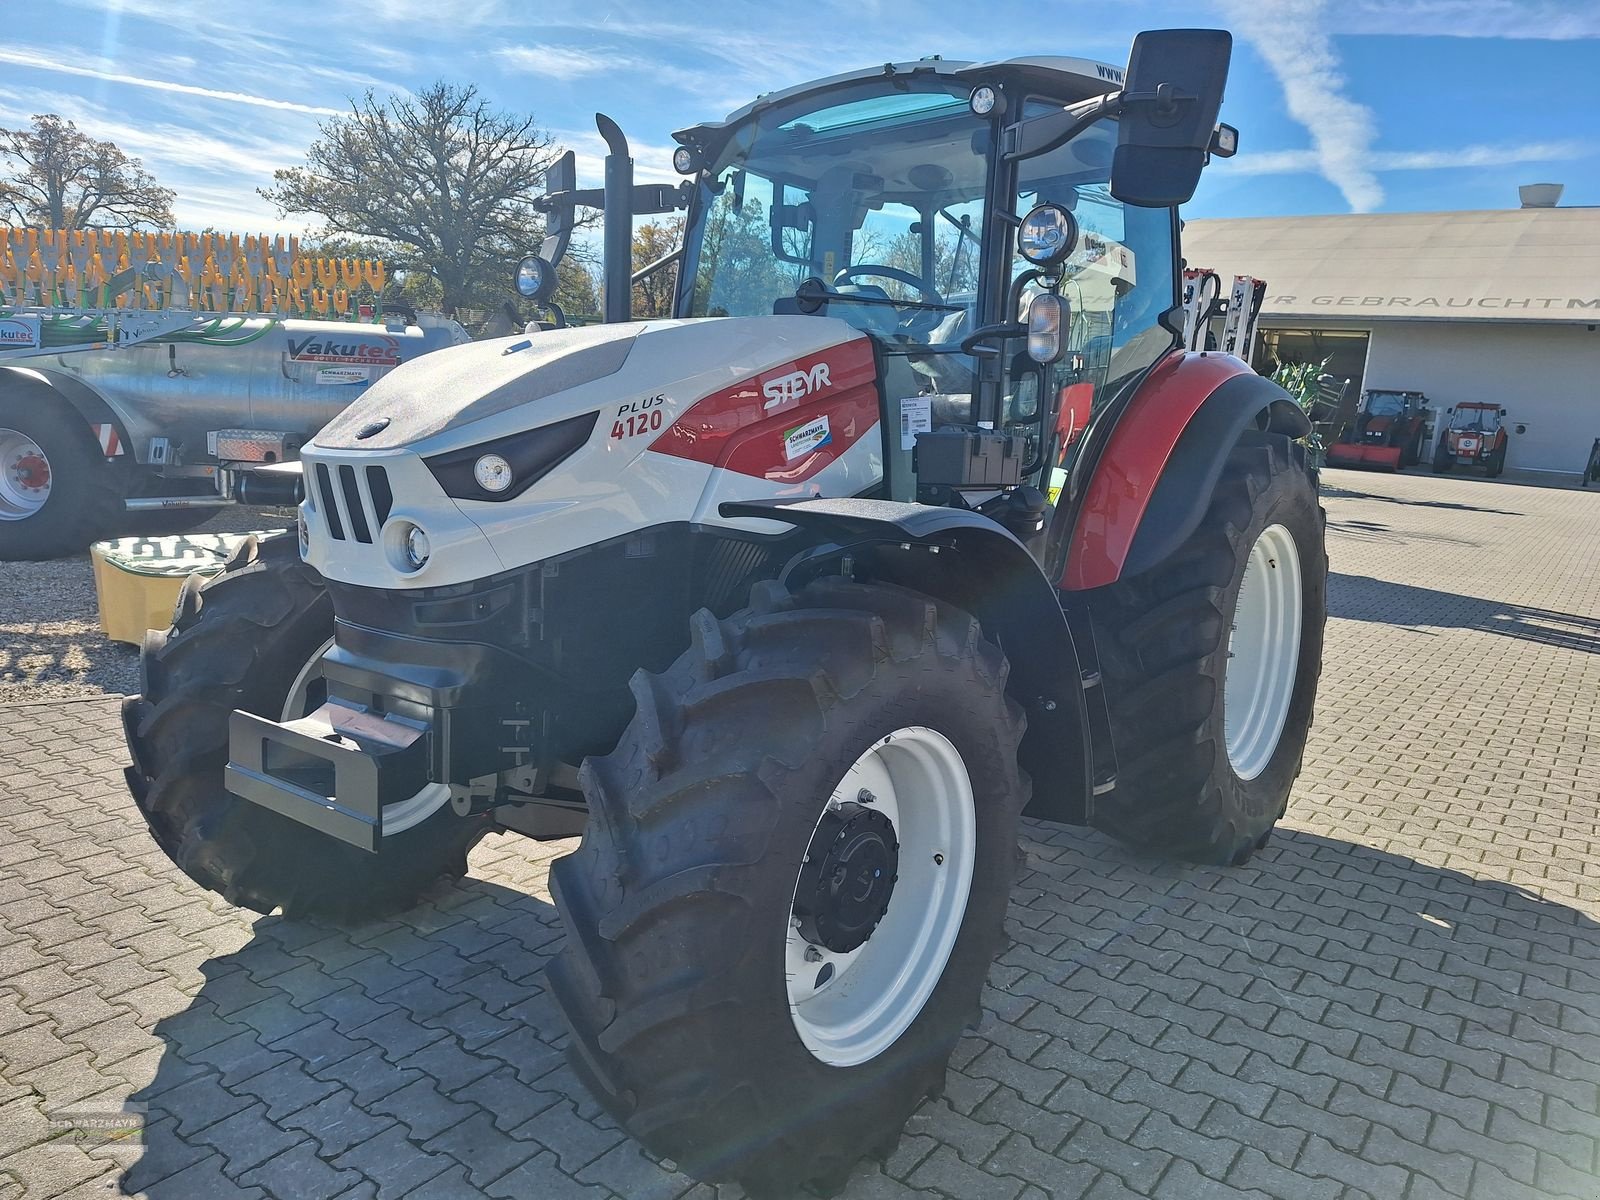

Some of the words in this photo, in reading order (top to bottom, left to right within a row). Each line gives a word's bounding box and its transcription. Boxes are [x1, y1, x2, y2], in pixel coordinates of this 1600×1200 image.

[0, 330, 33, 340] kutec
[287, 335, 399, 360] Vakutec
[763, 362, 832, 410] STEYR
[617, 394, 665, 417] PLUS
[610, 409, 663, 441] 4120
[789, 424, 824, 443] SCHWARZMAYR
